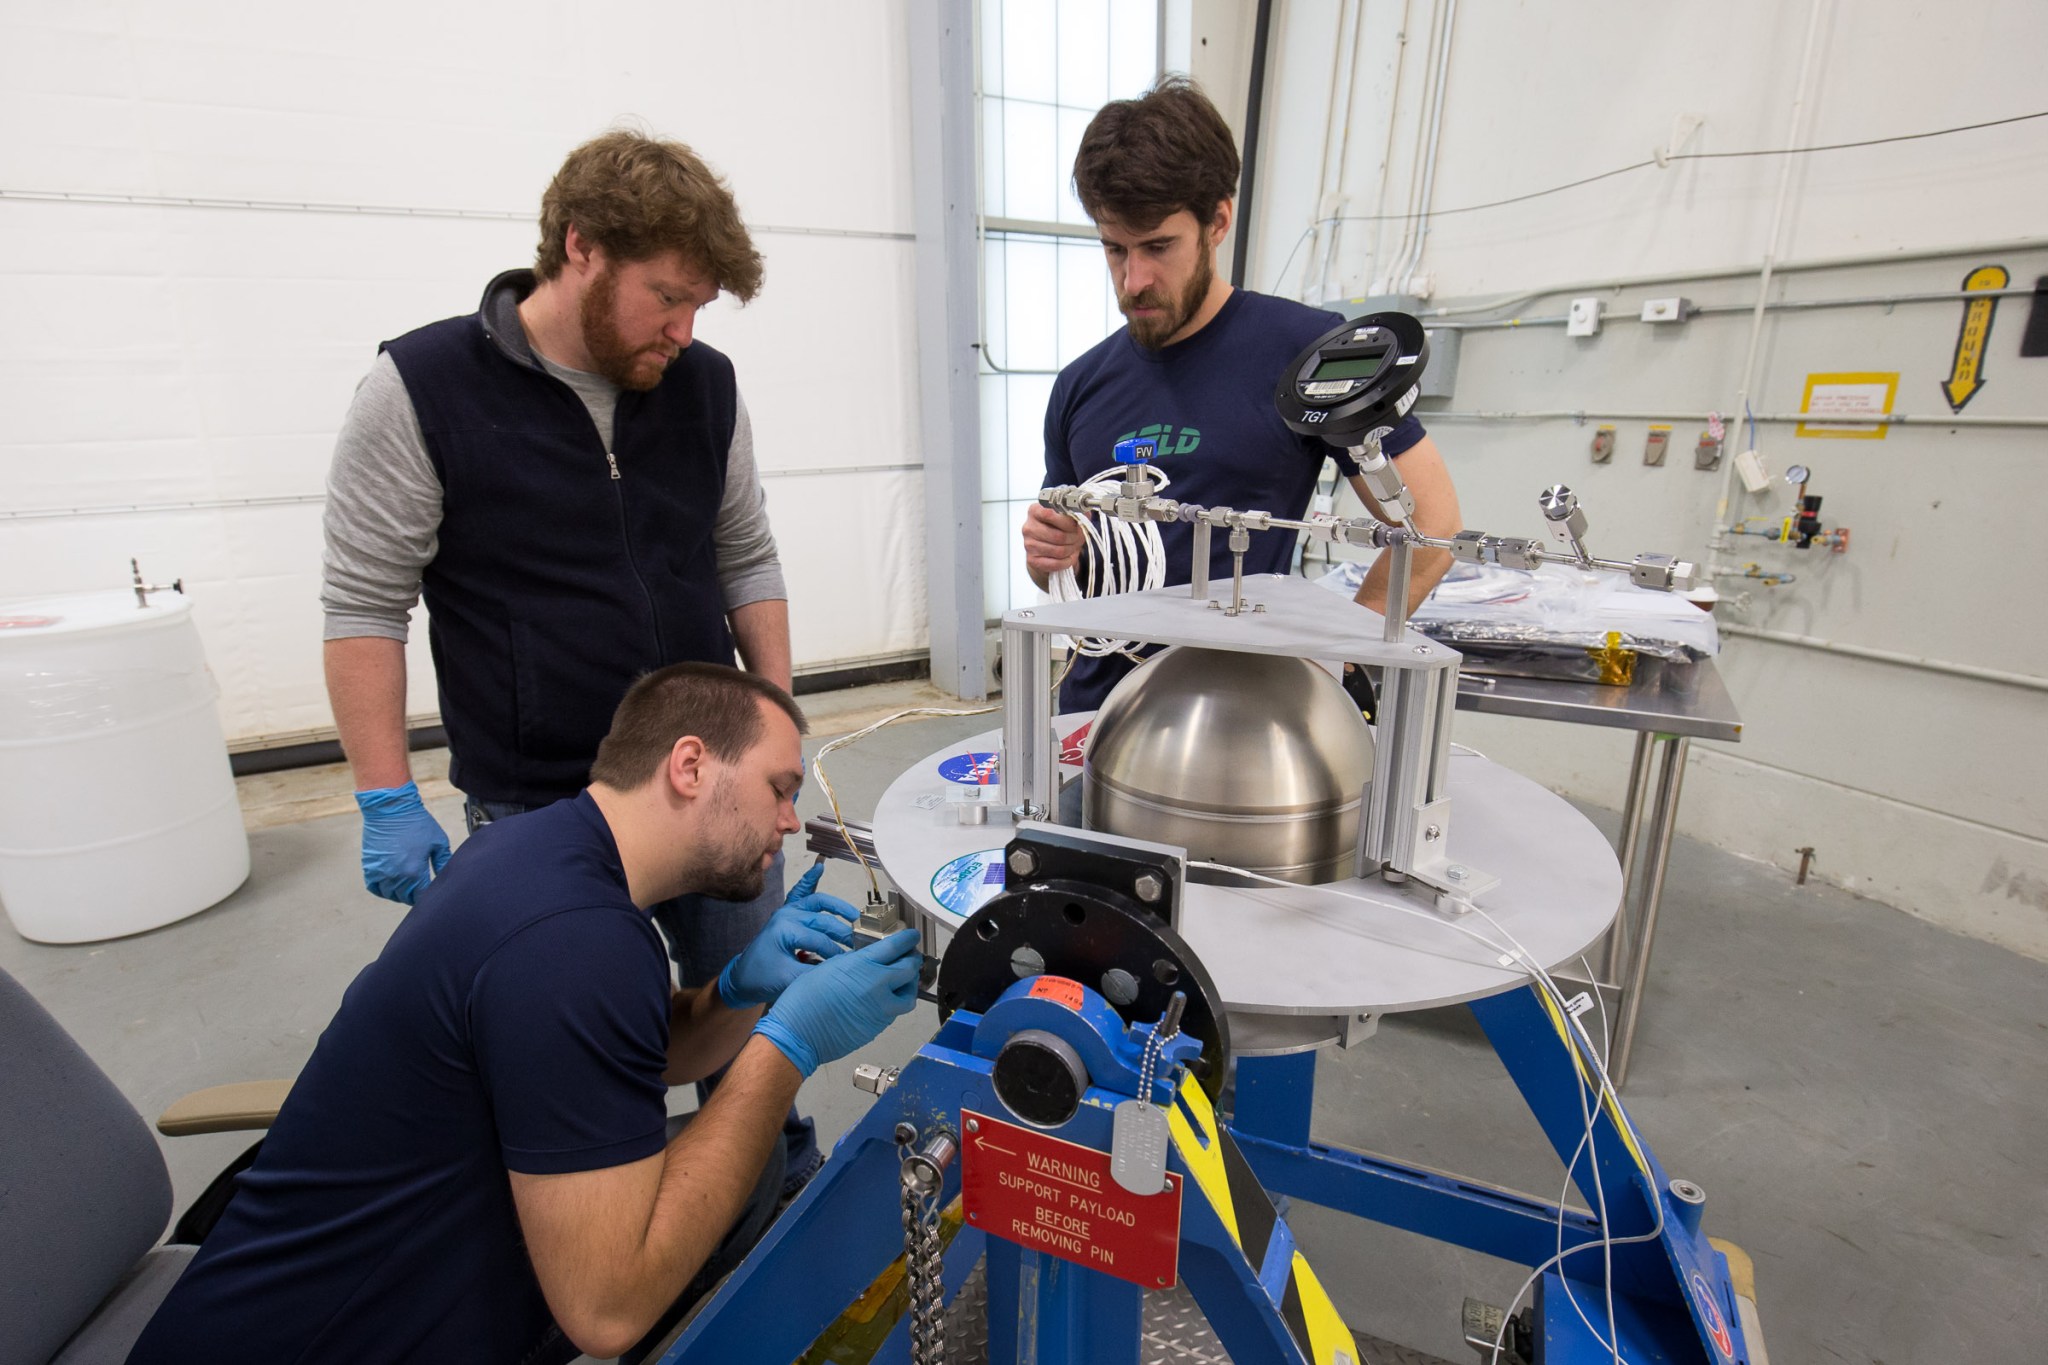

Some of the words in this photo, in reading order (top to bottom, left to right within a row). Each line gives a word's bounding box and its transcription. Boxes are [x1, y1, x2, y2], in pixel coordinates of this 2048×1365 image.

[1301, 410, 1329, 423] TG1
[1136, 446, 1153, 459] FVV
[1027, 1152, 1100, 1187] WARNING
[999, 1172, 1061, 1203] SUPPORT
[1070, 1195, 1136, 1227] PAYLOAD
[1035, 1206, 1091, 1234] BEFORE
[1012, 1219, 1082, 1254] REMOVING
[1091, 1246, 1114, 1265] PIN
